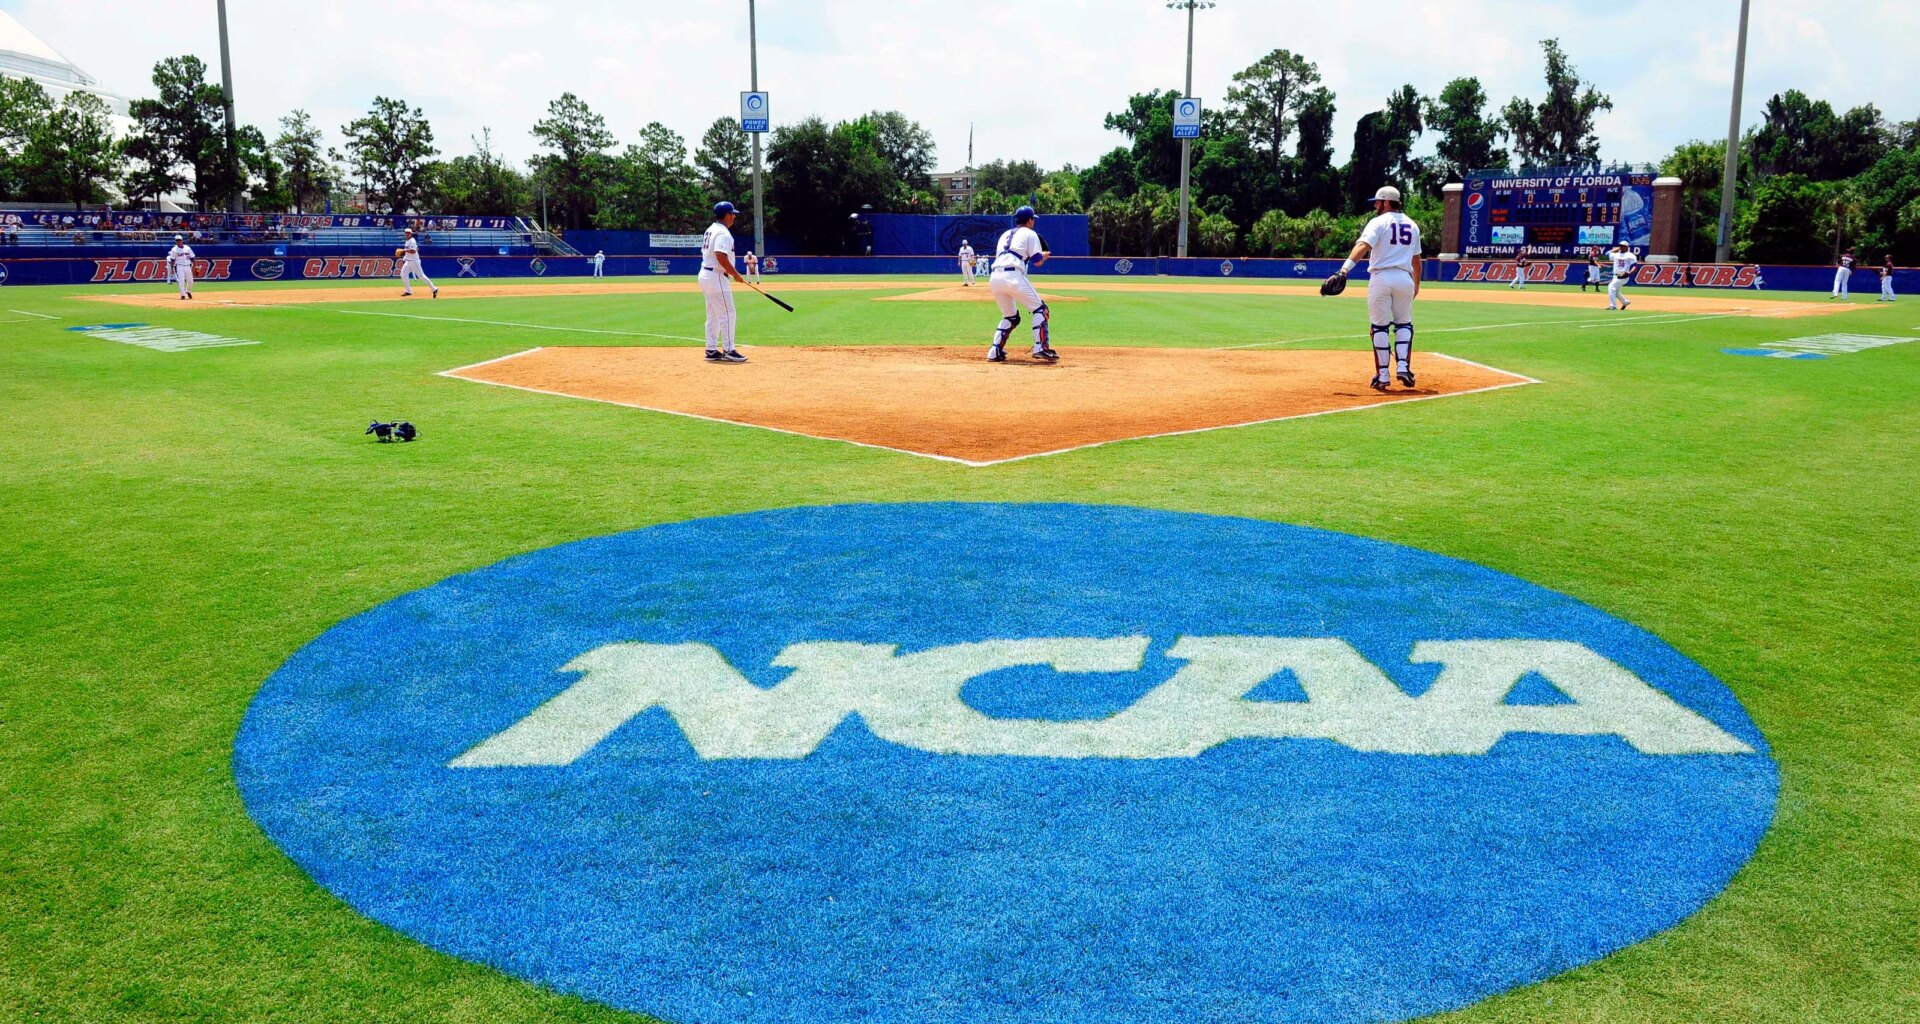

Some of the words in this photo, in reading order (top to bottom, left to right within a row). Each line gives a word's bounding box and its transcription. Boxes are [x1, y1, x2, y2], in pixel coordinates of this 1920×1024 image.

[1491, 178, 1553, 189] UNIVERSITY
[1555, 177, 1570, 187] OF
[1573, 176, 1622, 187] FLORIDA
[338, 217, 360, 227] '88
[464, 219, 482, 228] '10
[489, 219, 506, 228] '11
[1469, 210, 1479, 243] pepsi
[1389, 222, 1412, 246] 15
[1465, 245, 1515, 254] McKETHAN
[1520, 245, 1561, 254] SADIUM
[1573, 246, 1606, 255] PERY
[91, 259, 233, 281] FLORDA
[1634, 264, 1757, 287] GATORS
[448, 634, 1757, 768] NCAA
